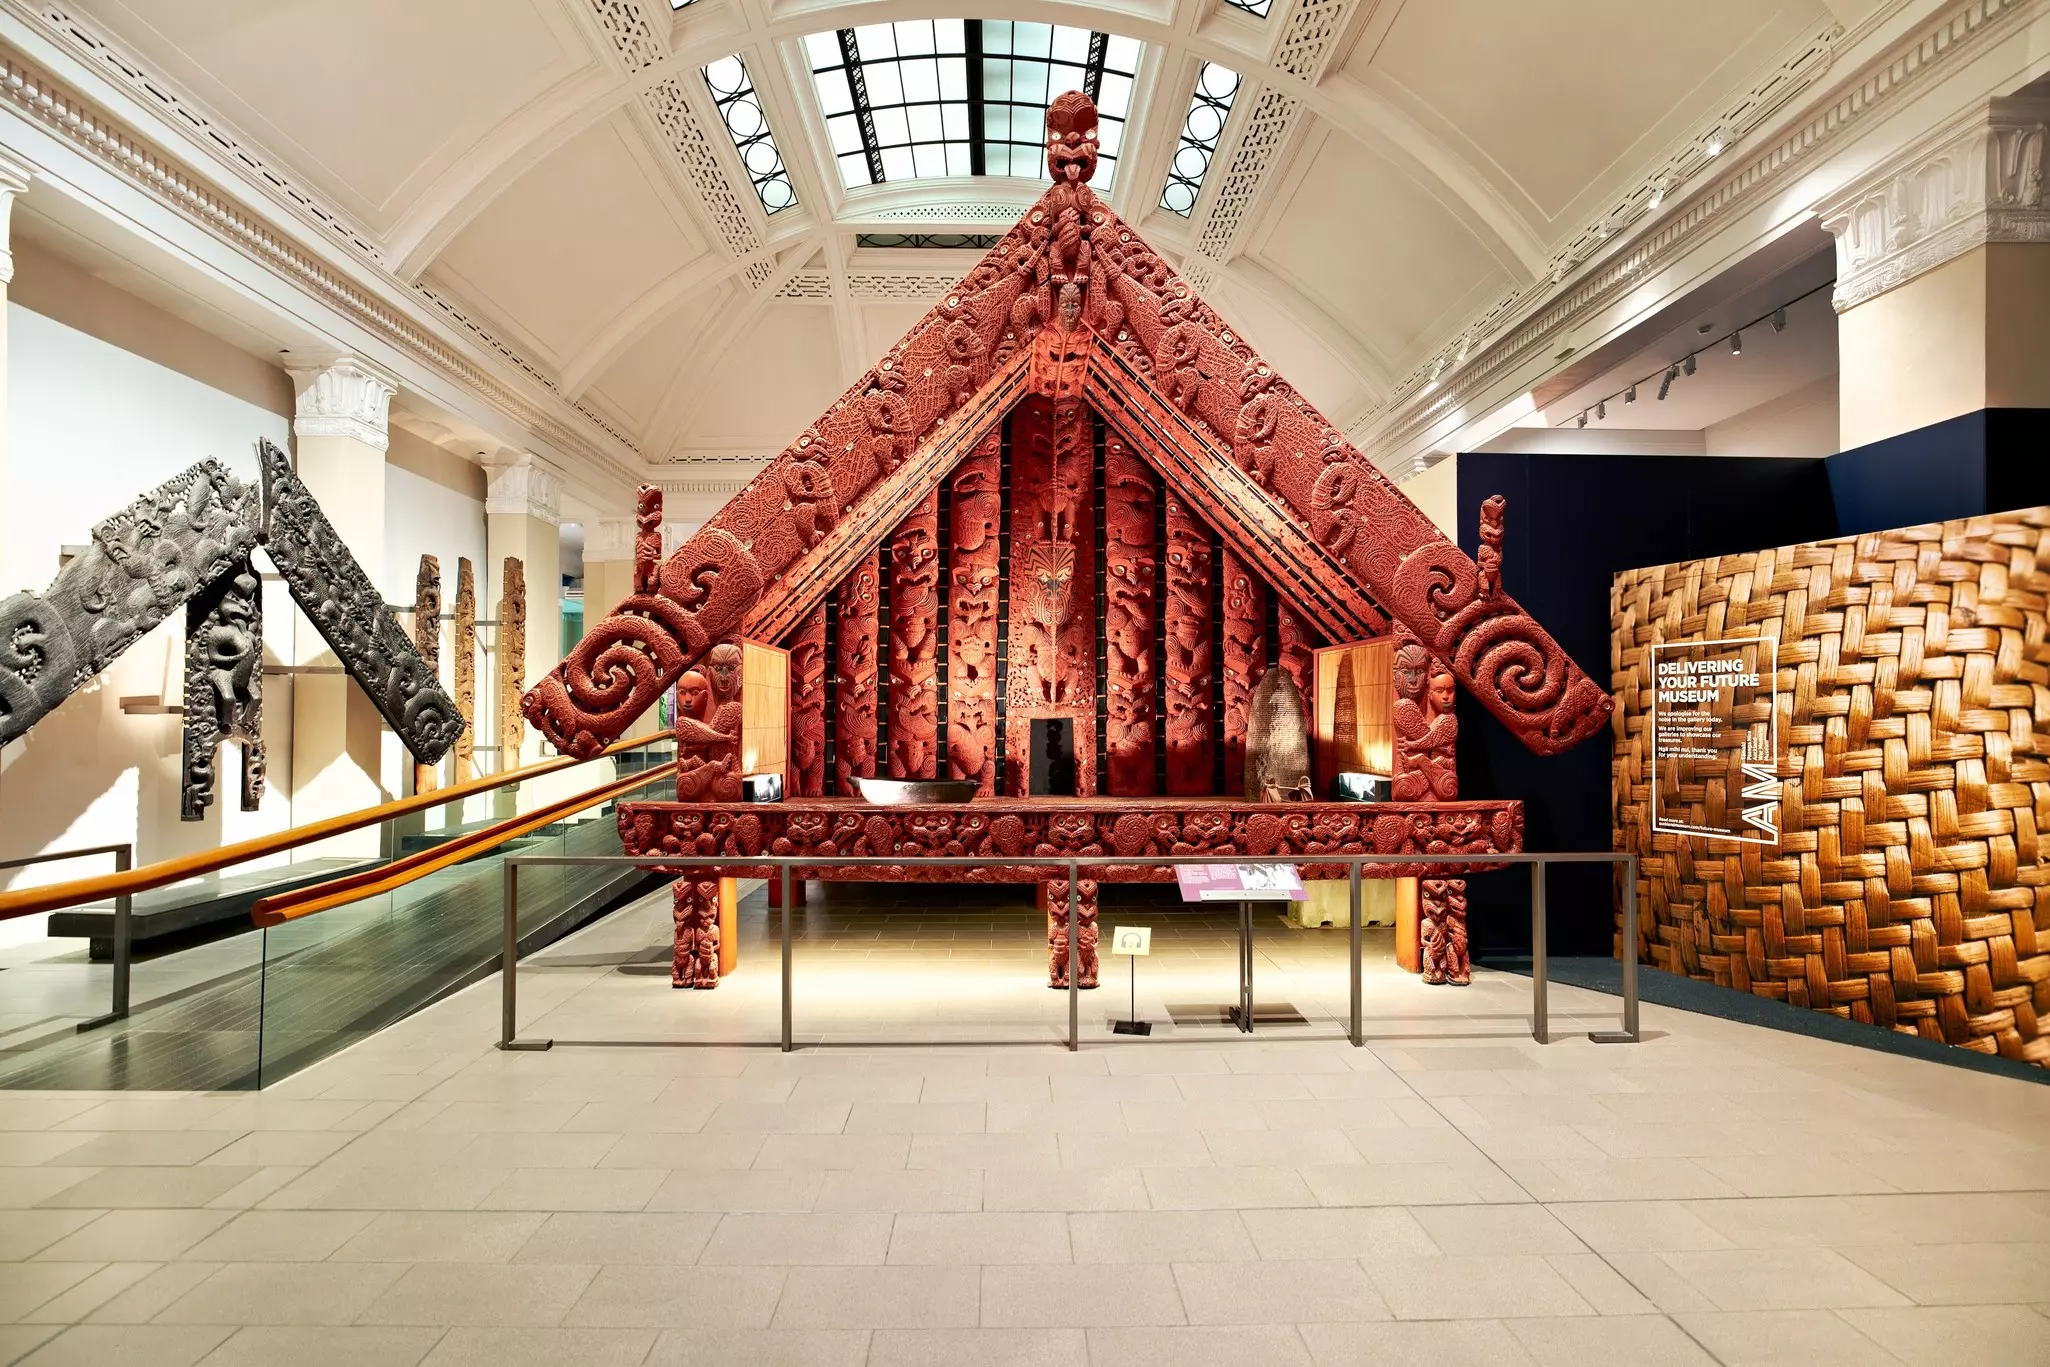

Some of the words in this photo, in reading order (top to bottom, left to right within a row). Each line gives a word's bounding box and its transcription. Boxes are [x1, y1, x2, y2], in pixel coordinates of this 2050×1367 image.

[1658, 659, 1744, 675] DELIVERING
[1658, 676, 1697, 689] YOUR
[1700, 673, 1760, 688] FUTURE
[1658, 690, 1720, 703] MUSEUM
[1741, 763, 1778, 835] AM
